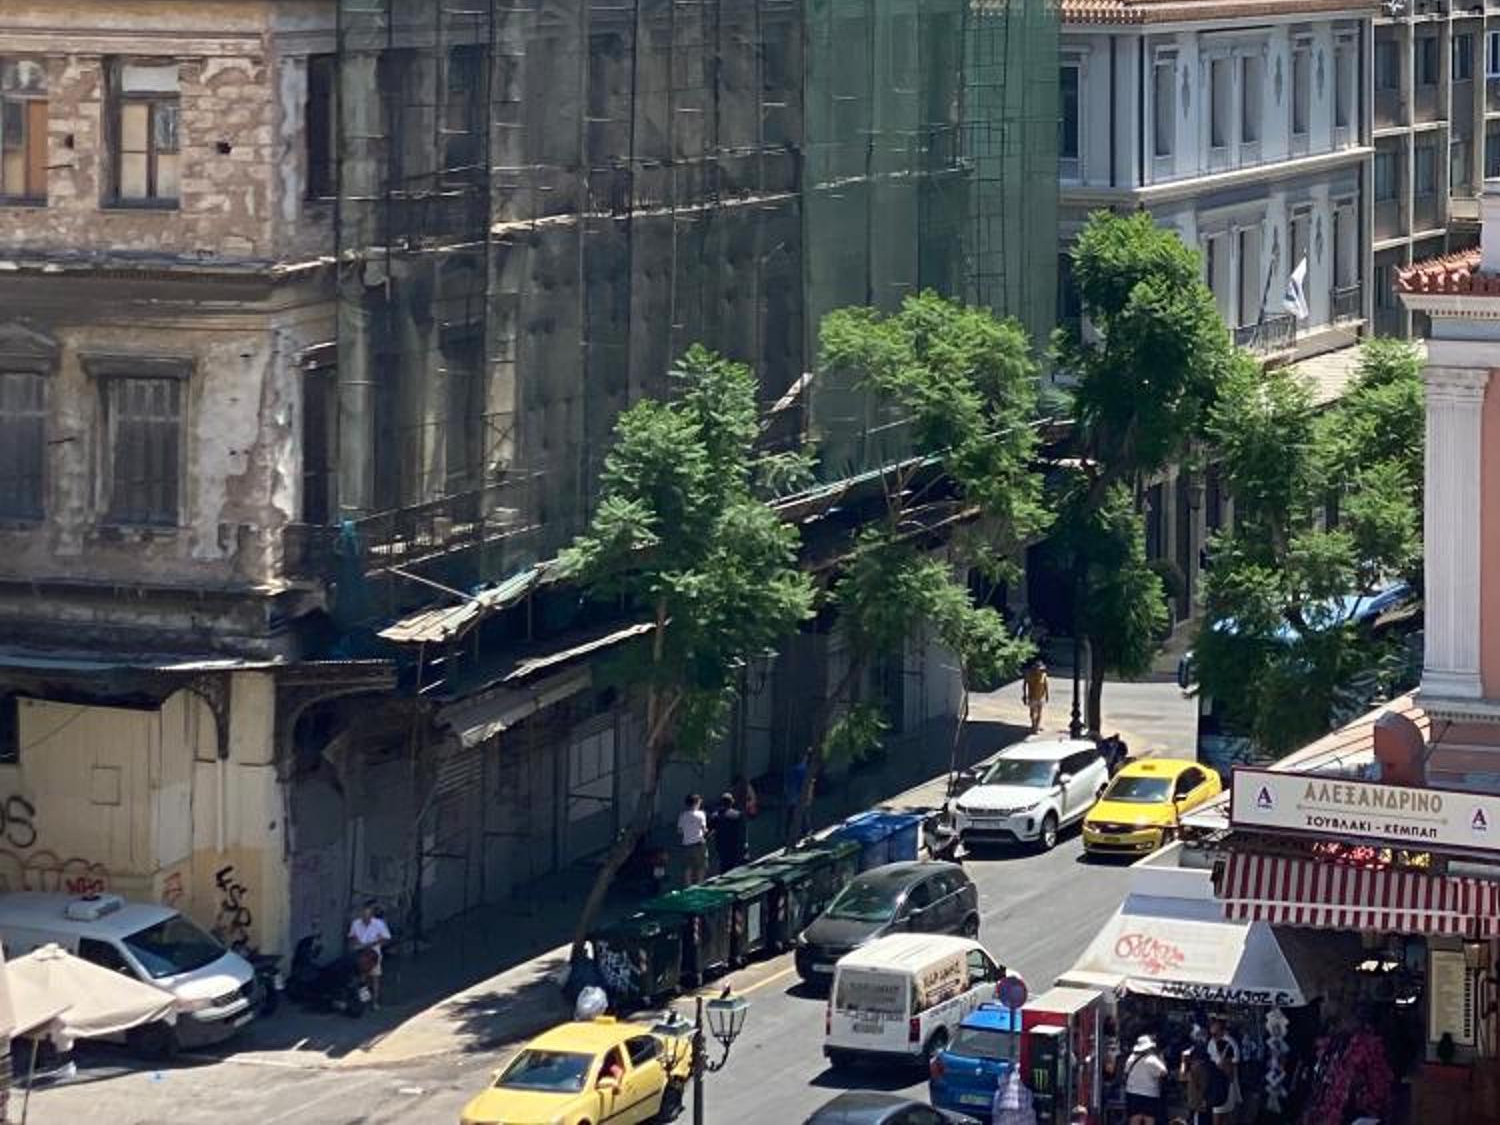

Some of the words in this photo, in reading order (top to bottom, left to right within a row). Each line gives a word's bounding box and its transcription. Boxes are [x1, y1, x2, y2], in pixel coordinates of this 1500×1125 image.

[1303, 781, 1443, 814] ΑΛΕΞΑΝΔΡΙΝΟ
[1306, 815, 1372, 833] ΣΟΥΒΛΑΚΙ
[1384, 824, 1438, 839] ΚΕΜΠΑΠ
